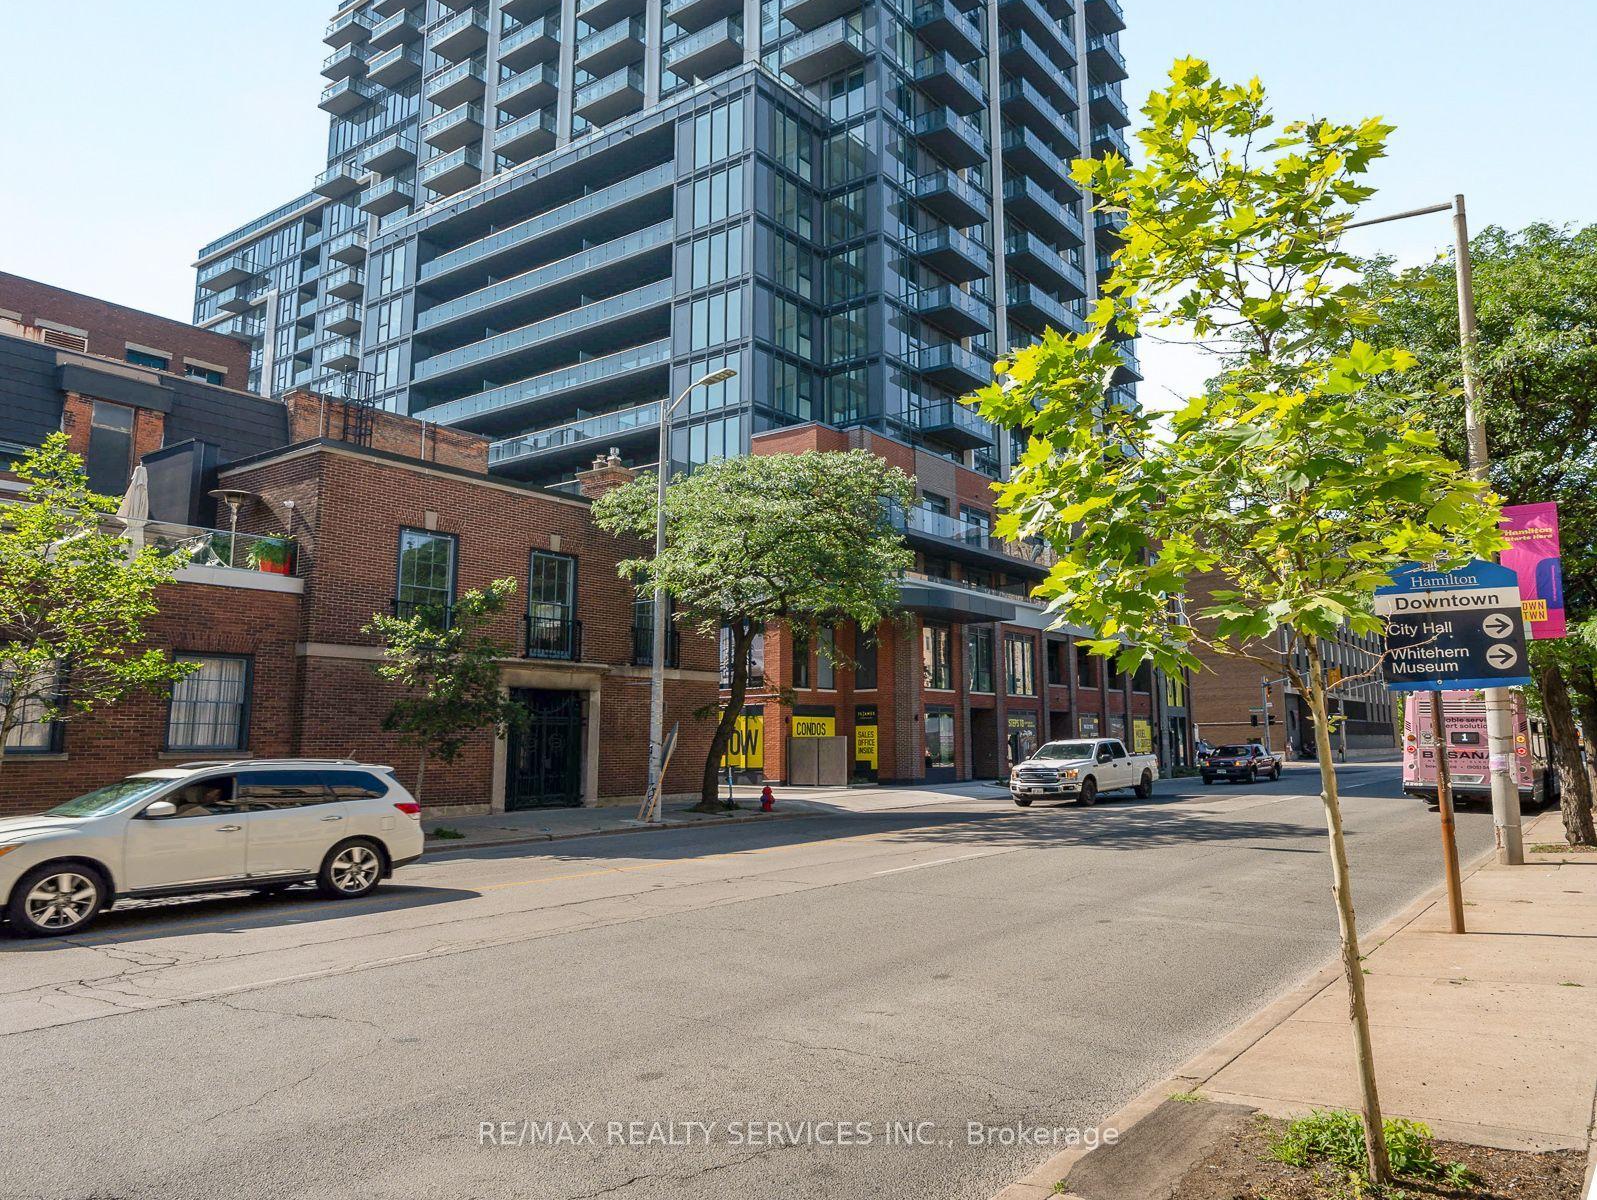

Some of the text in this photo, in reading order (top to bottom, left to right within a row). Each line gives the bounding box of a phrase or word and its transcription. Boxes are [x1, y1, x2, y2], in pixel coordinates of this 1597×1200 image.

[1504, 528, 1553, 536] Hamilton
[1410, 573, 1478, 588] Hamilton
[1394, 594, 1500, 611] Downtown
[1522, 601, 1545, 611] DWN
[1523, 610, 1546, 621] TWN
[1388, 621, 1453, 638] City Hall
[1391, 646, 1470, 661] Whitehern
[1391, 661, 1459, 675] Museum
[796, 722, 826, 736] CONDOS
[729, 729, 758, 756] OW
[1461, 733, 1468, 741] 1
